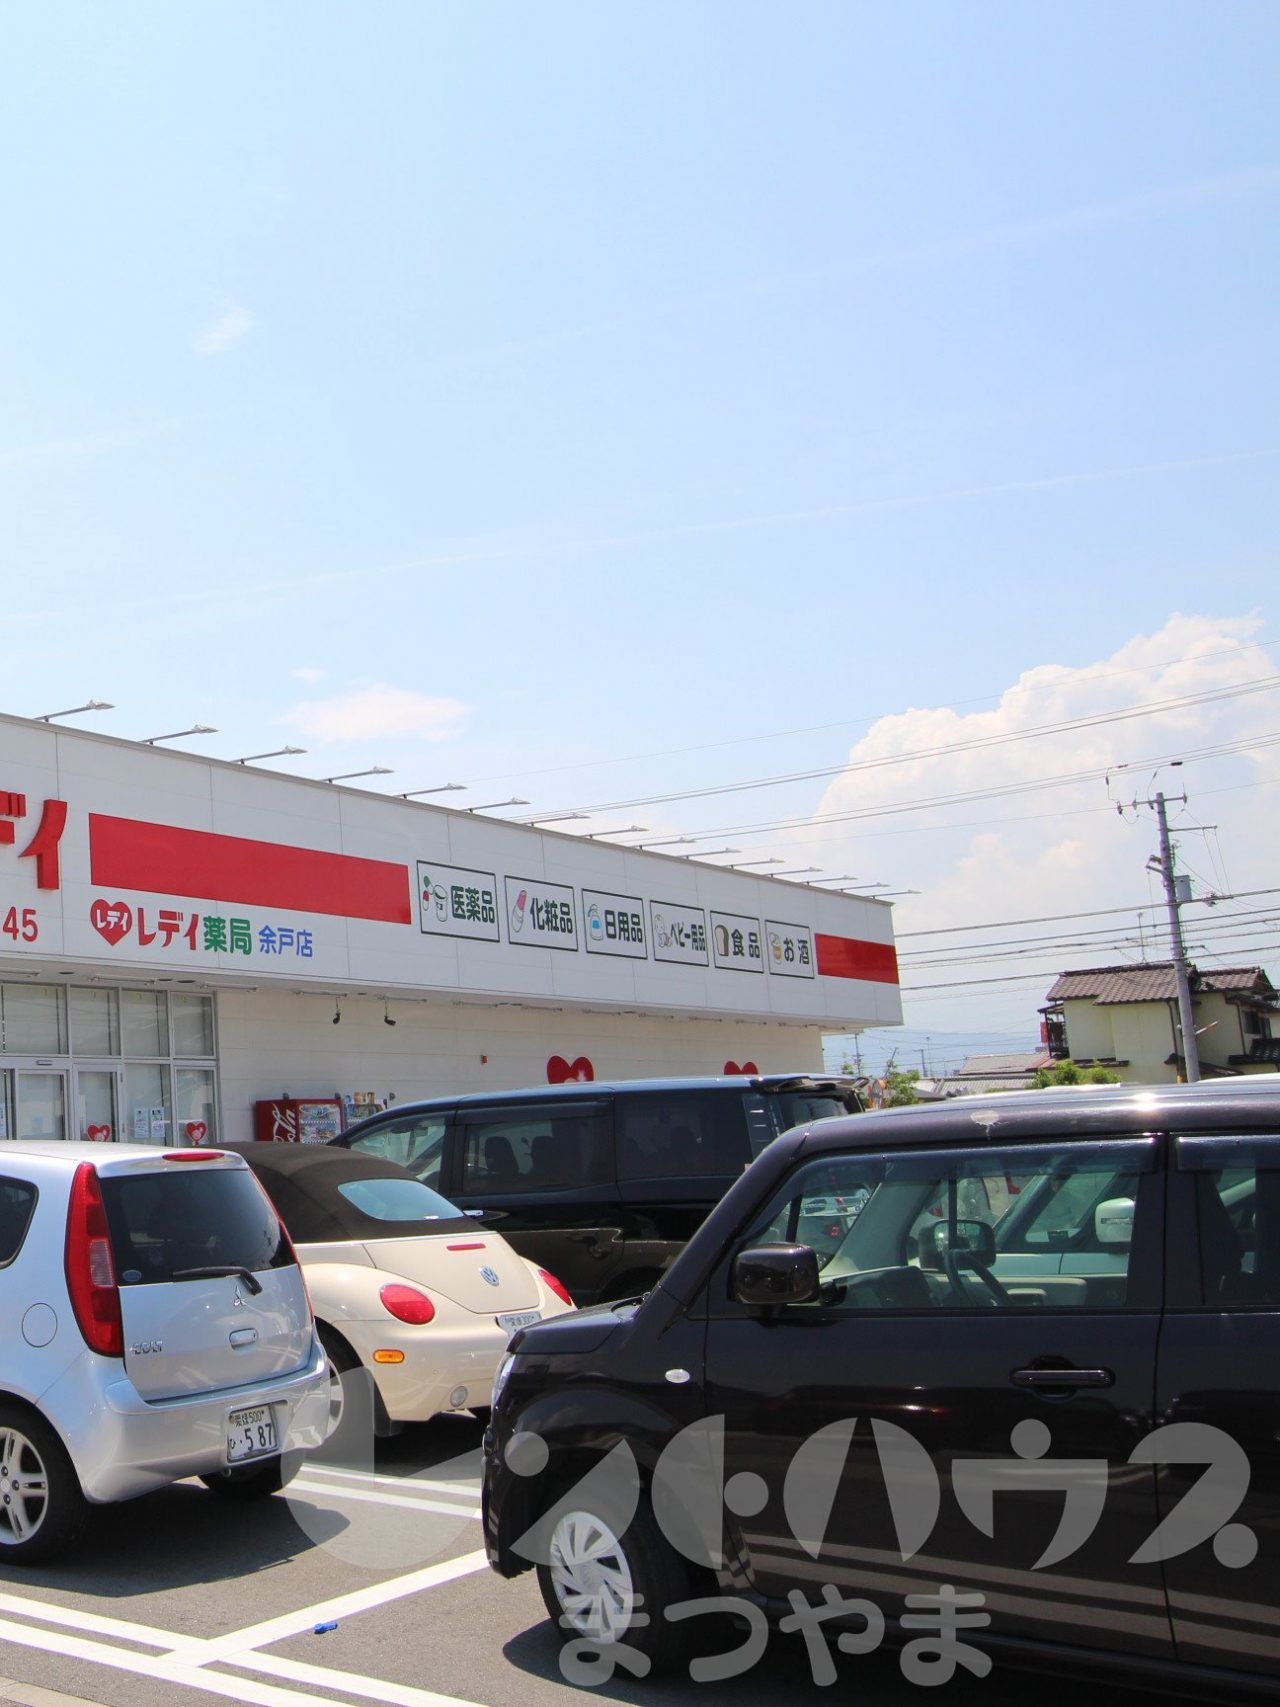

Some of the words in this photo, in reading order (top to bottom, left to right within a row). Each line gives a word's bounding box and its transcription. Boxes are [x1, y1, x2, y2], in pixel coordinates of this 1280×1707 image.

[451, 885, 495, 924] 医薬品
[530, 897, 573, 934] 化粧品
[258, 925, 313, 957] 余戸店
[604, 909, 643, 943] 日用品
[671, 921, 706, 952] ベビー用品
[731, 928, 761, 959] 食品
[783, 937, 810, 965] お酒
